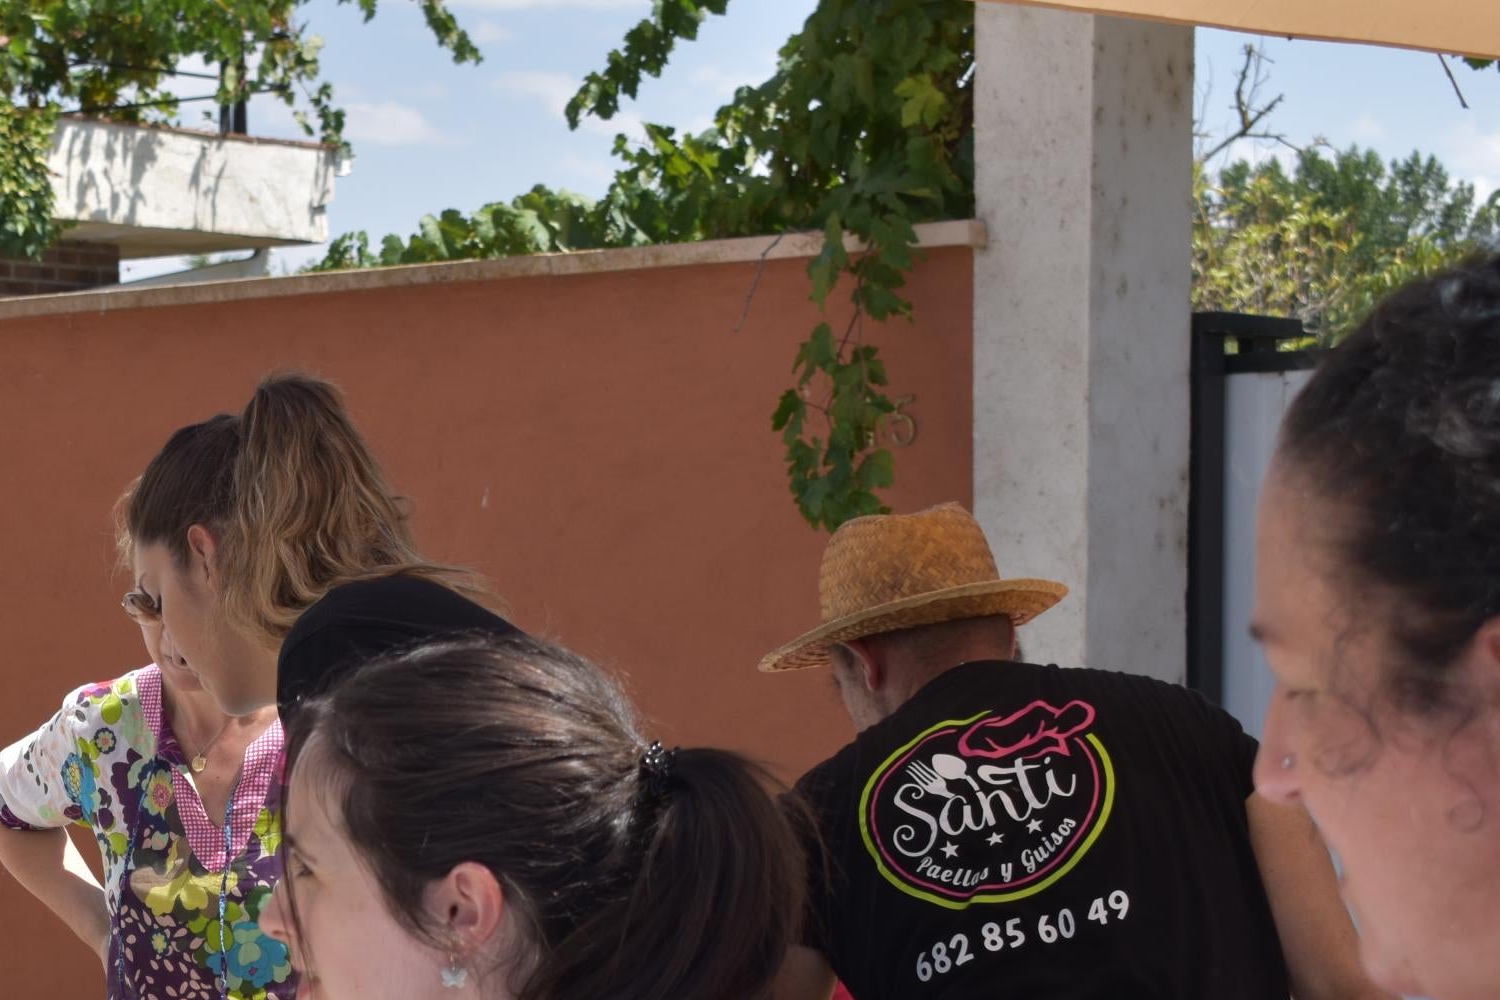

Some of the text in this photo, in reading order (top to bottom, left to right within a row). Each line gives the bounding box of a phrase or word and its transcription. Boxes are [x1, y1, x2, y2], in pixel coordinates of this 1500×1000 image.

[893, 756, 1076, 857] Santi
[915, 817, 1077, 887] Paellas y Guisos
[916, 890, 1130, 982] 682 85 60 49
